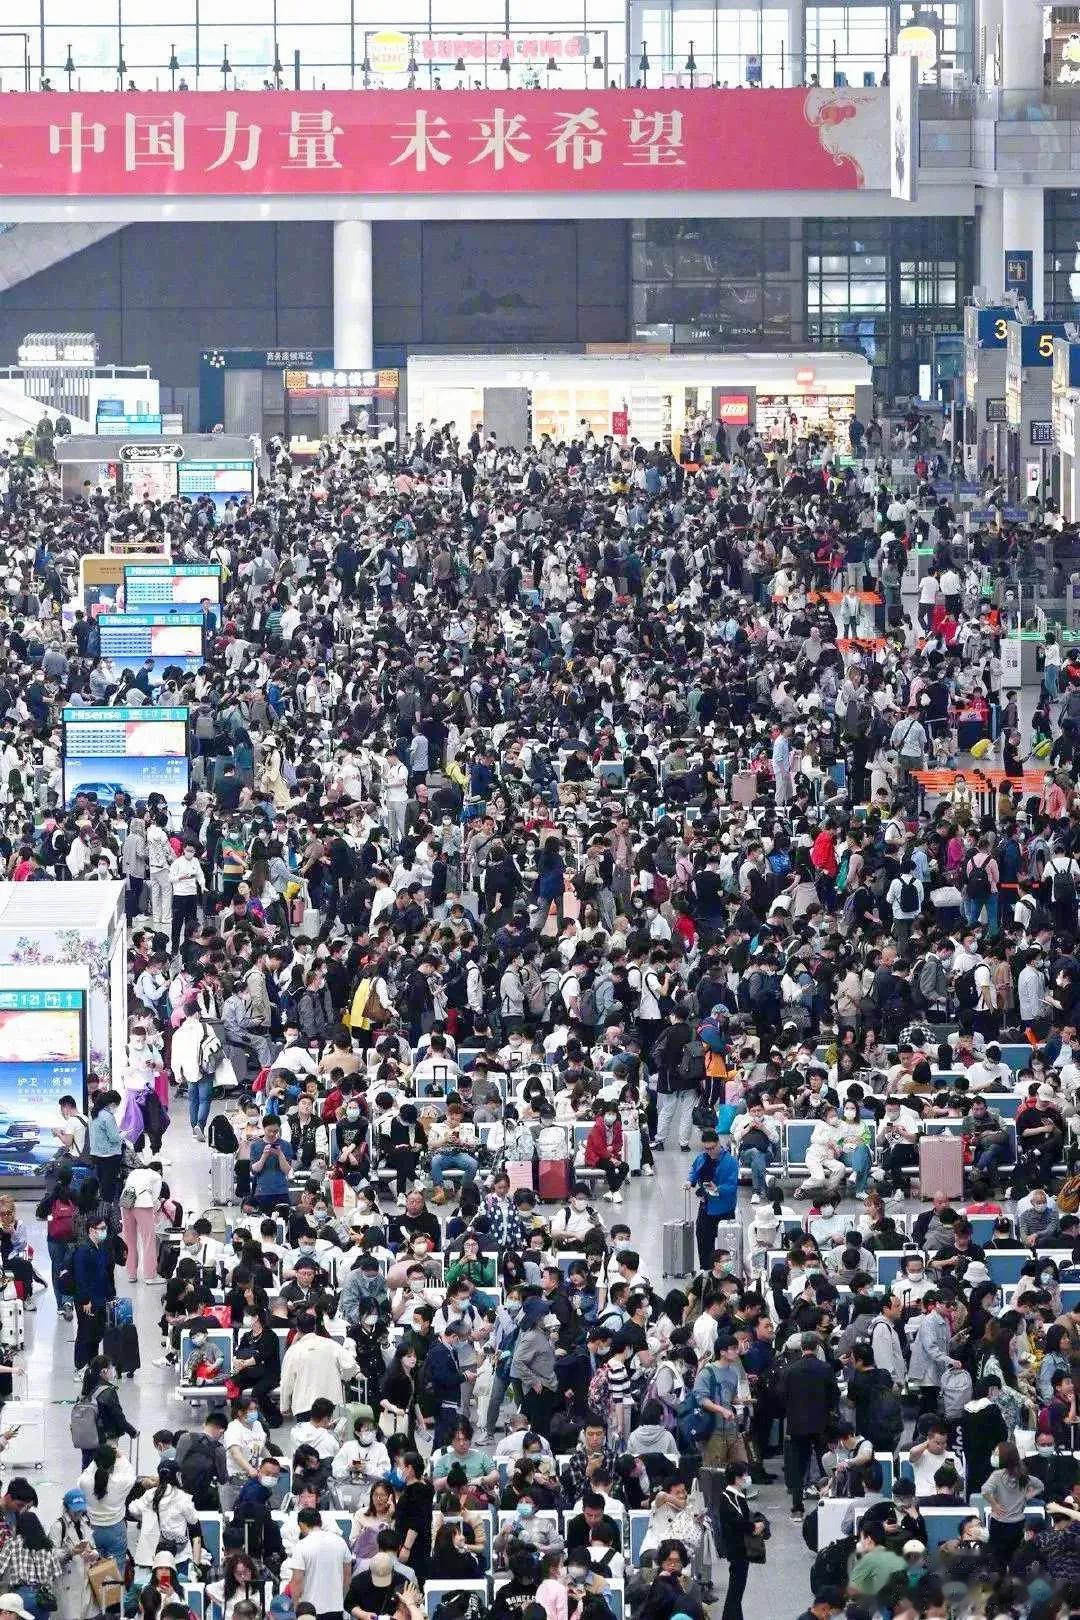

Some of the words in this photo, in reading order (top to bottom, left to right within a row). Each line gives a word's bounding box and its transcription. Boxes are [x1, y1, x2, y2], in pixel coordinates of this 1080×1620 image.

[49, 109, 345, 174] 中国力量
[390, 107, 687, 173] 未来希望
[994, 319, 1008, 340] 3
[1038, 334, 1054, 358] 5
